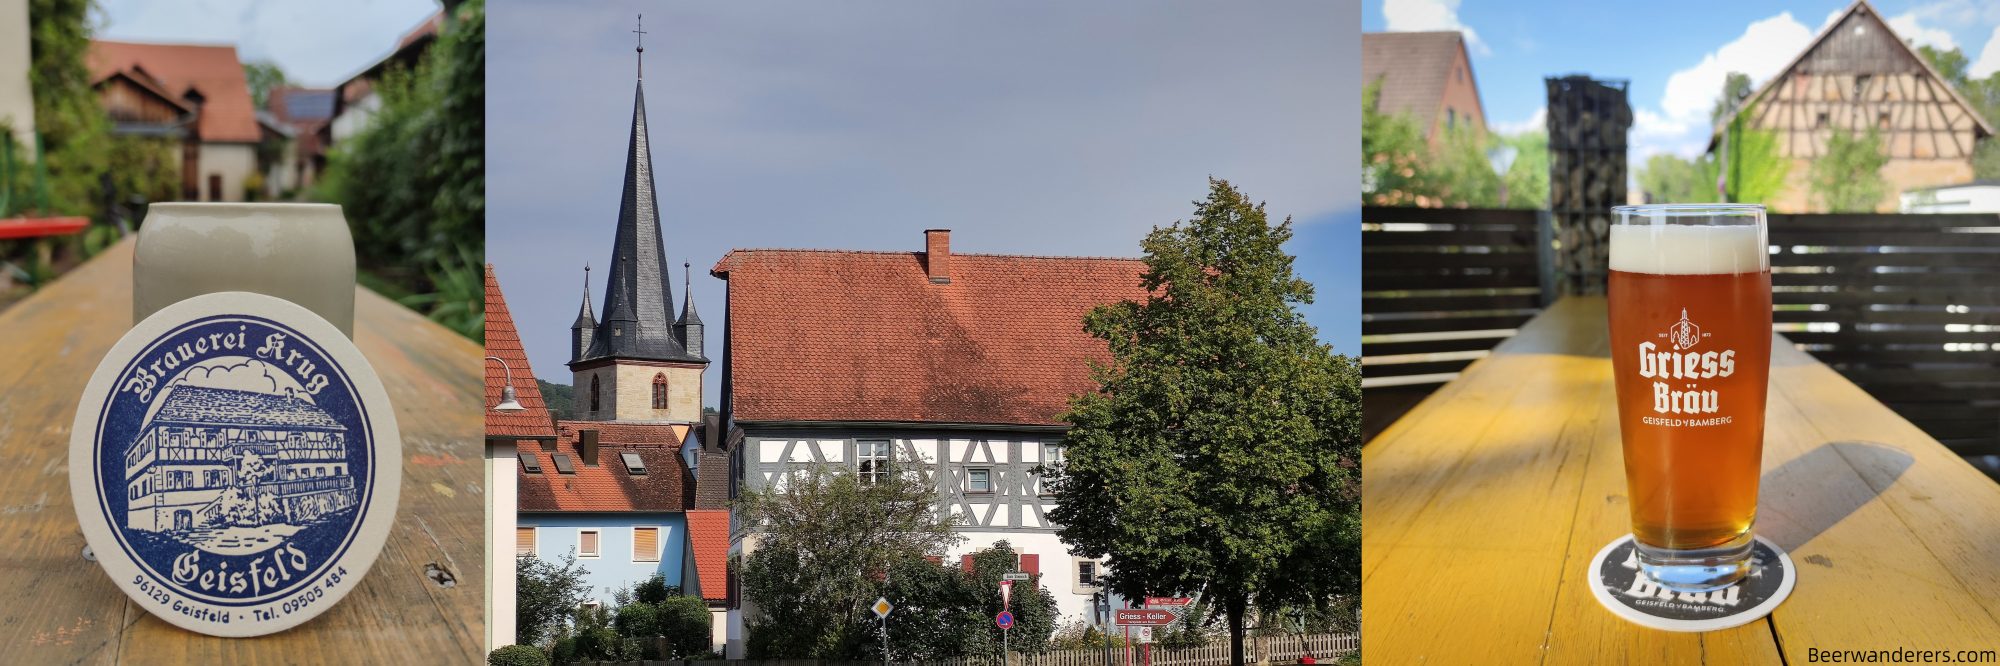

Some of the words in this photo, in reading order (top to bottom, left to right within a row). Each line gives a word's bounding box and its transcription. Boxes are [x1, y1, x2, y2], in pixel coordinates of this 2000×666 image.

[122, 325, 247, 403] Brauerei
[256, 332, 330, 395] Krug
[1639, 341, 1736, 380] Griess
[1653, 381, 1719, 414] Bräu
[1642, 416, 1682, 427] GEISFELD
[1689, 416, 1732, 427] BAMBERG
[172, 542, 307, 597] Geisfeld
[132, 575, 170, 605] 96129
[172, 600, 230, 623] Geisfeld
[253, 607, 280, 622] Tel.
[282, 586, 324, 614] 09505
[325, 566, 348, 588] 484
[1635, 599, 1675, 609] GEISFELD
[1682, 604, 1725, 613] BAMBERG
[1120, 612, 1141, 620] Griess
[1146, 612, 1167, 620] Keller
